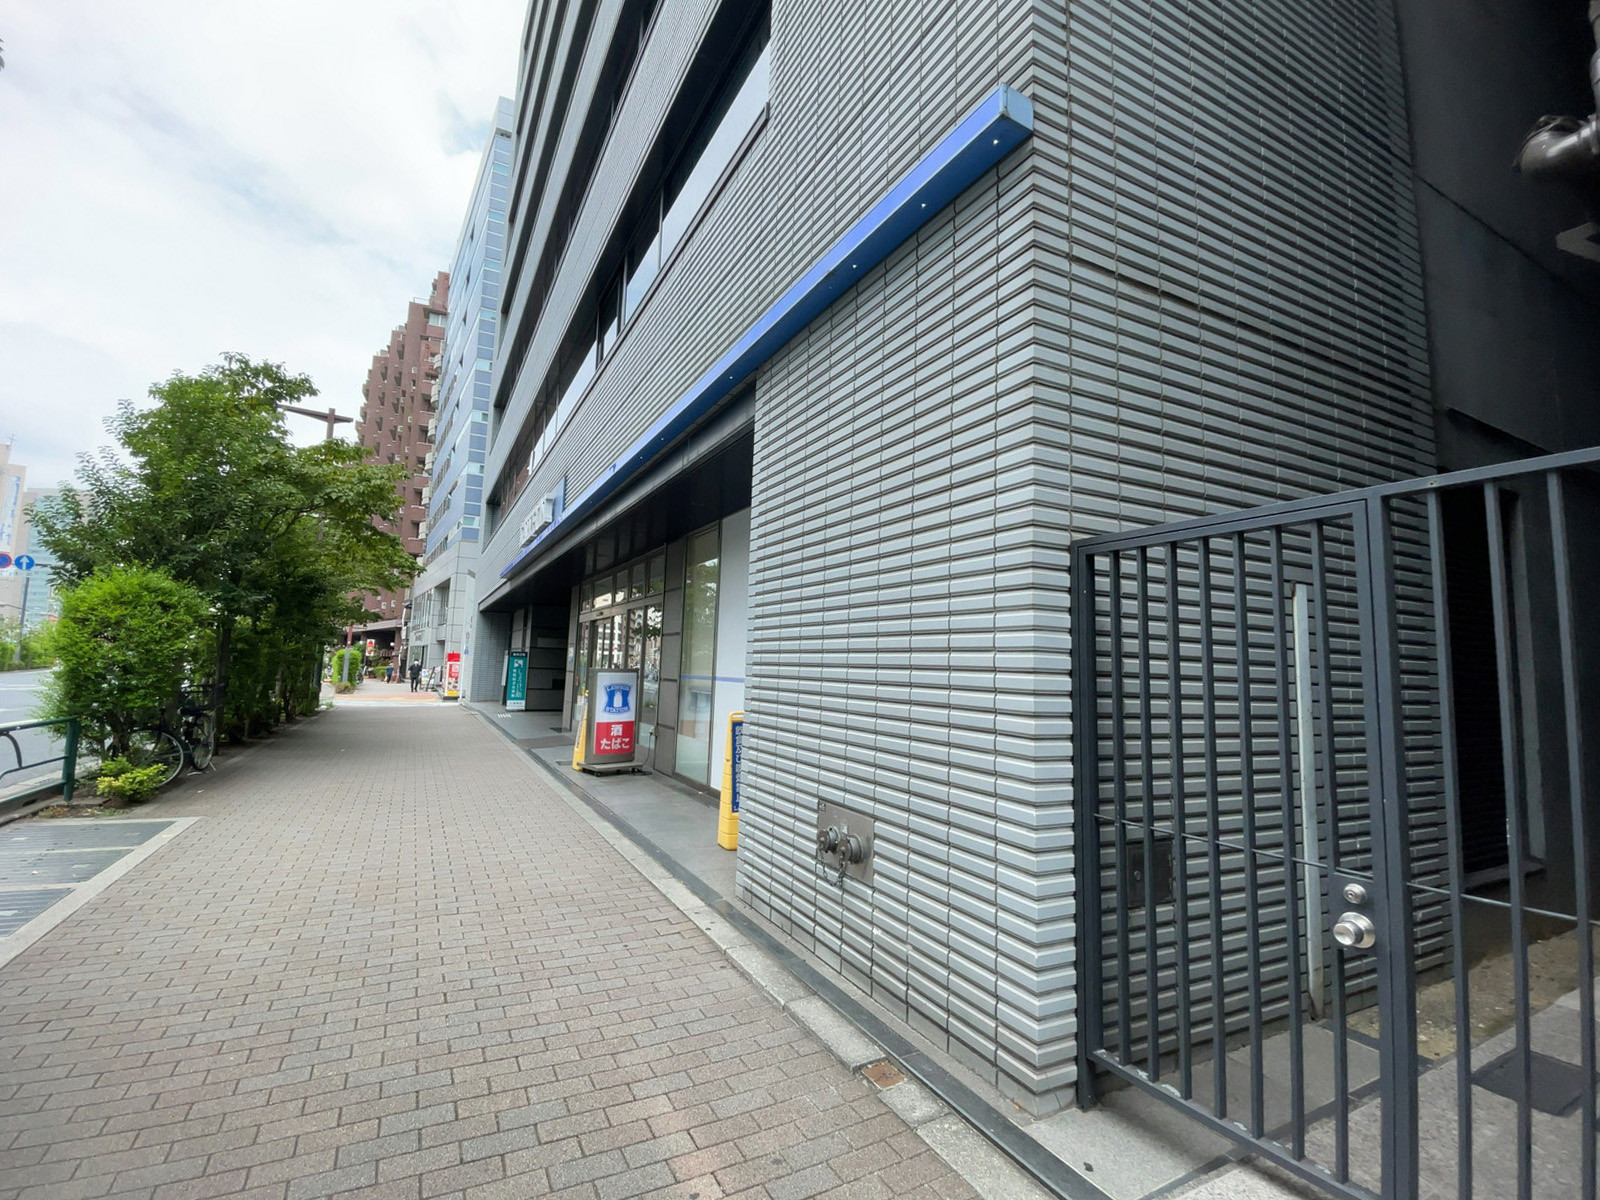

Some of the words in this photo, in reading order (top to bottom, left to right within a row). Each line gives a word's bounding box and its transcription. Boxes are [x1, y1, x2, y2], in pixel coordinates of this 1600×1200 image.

[611, 724, 623, 736] 酒
[600, 738, 630, 750] たばこ
